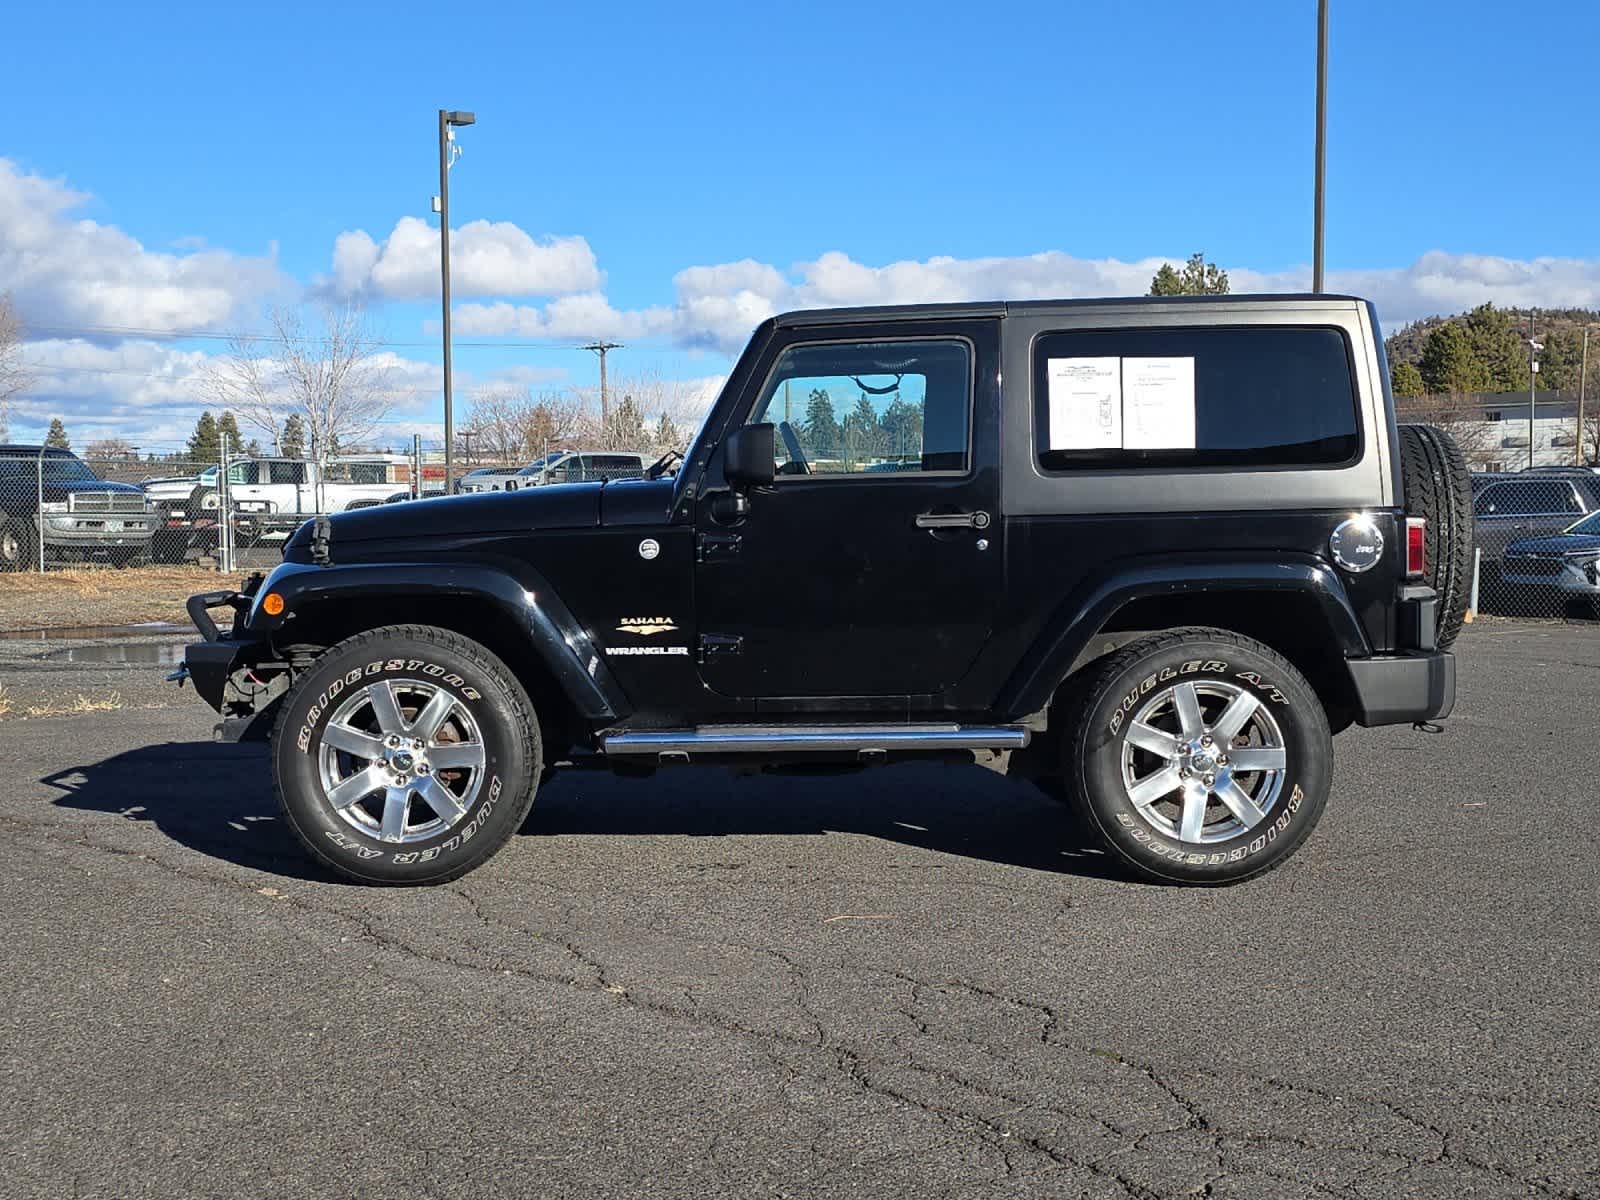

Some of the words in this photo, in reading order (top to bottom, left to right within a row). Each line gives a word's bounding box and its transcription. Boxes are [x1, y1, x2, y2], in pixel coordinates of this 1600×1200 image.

[605, 647, 689, 656] WRANGLER
[620, 617, 674, 625] SAHARA
[297, 659, 482, 755] BRIDGESTONE
[1109, 660, 1228, 736] DUELER
[1236, 671, 1290, 705] A/T
[324, 830, 385, 860] A/T
[392, 775, 503, 865] DUELER
[1116, 783, 1305, 865] BRIDGESTONE
